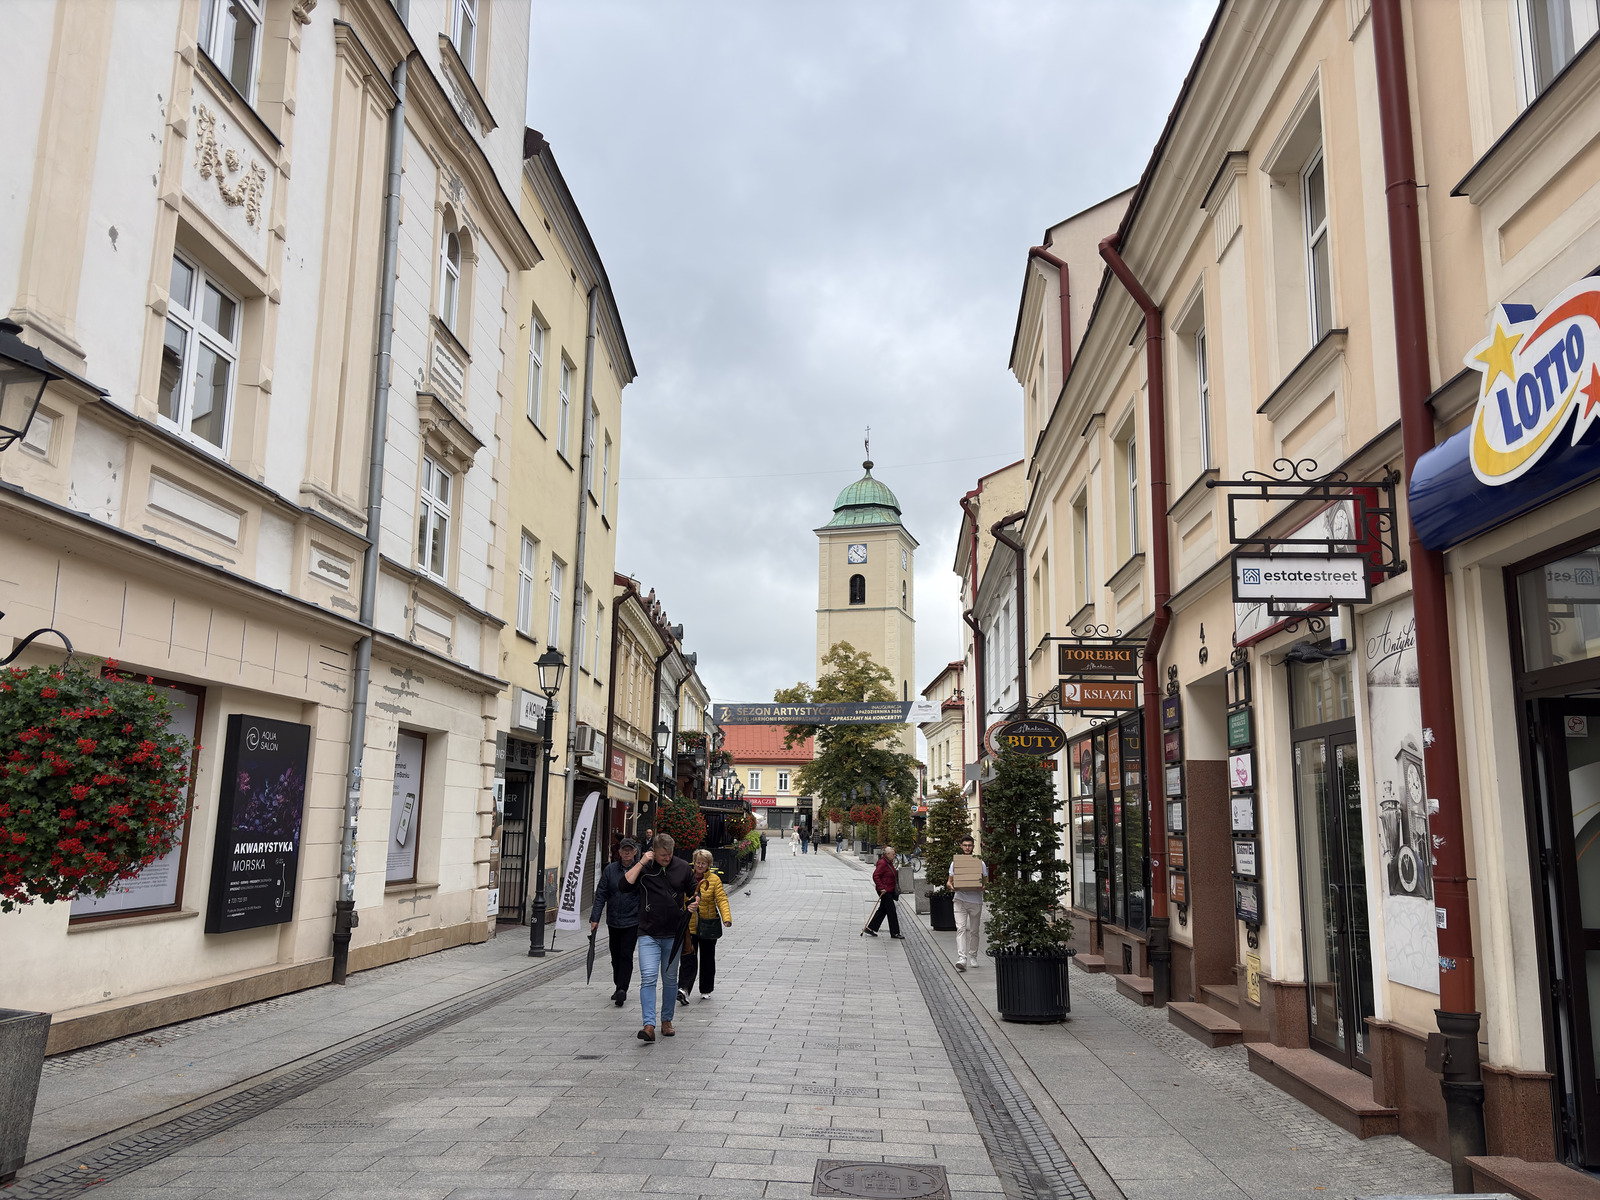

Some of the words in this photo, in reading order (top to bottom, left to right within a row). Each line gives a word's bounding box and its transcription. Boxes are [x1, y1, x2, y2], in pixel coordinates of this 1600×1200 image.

[1496, 323, 1585, 445] LOTTO
[1264, 570, 1358, 581] estatestreet
[1065, 650, 1131, 661] TOREBKI
[737, 707, 771, 716] SEZON
[773, 706, 846, 716] ARTYSTYCZNY
[261, 731, 277, 741] AQUA
[1008, 735, 1060, 748] BUTY
[260, 741, 279, 751] SALON
[234, 841, 294, 855] AKWARYSTYKA
[232, 859, 266, 872] MORSKA
[561, 871, 573, 911] KAWA
